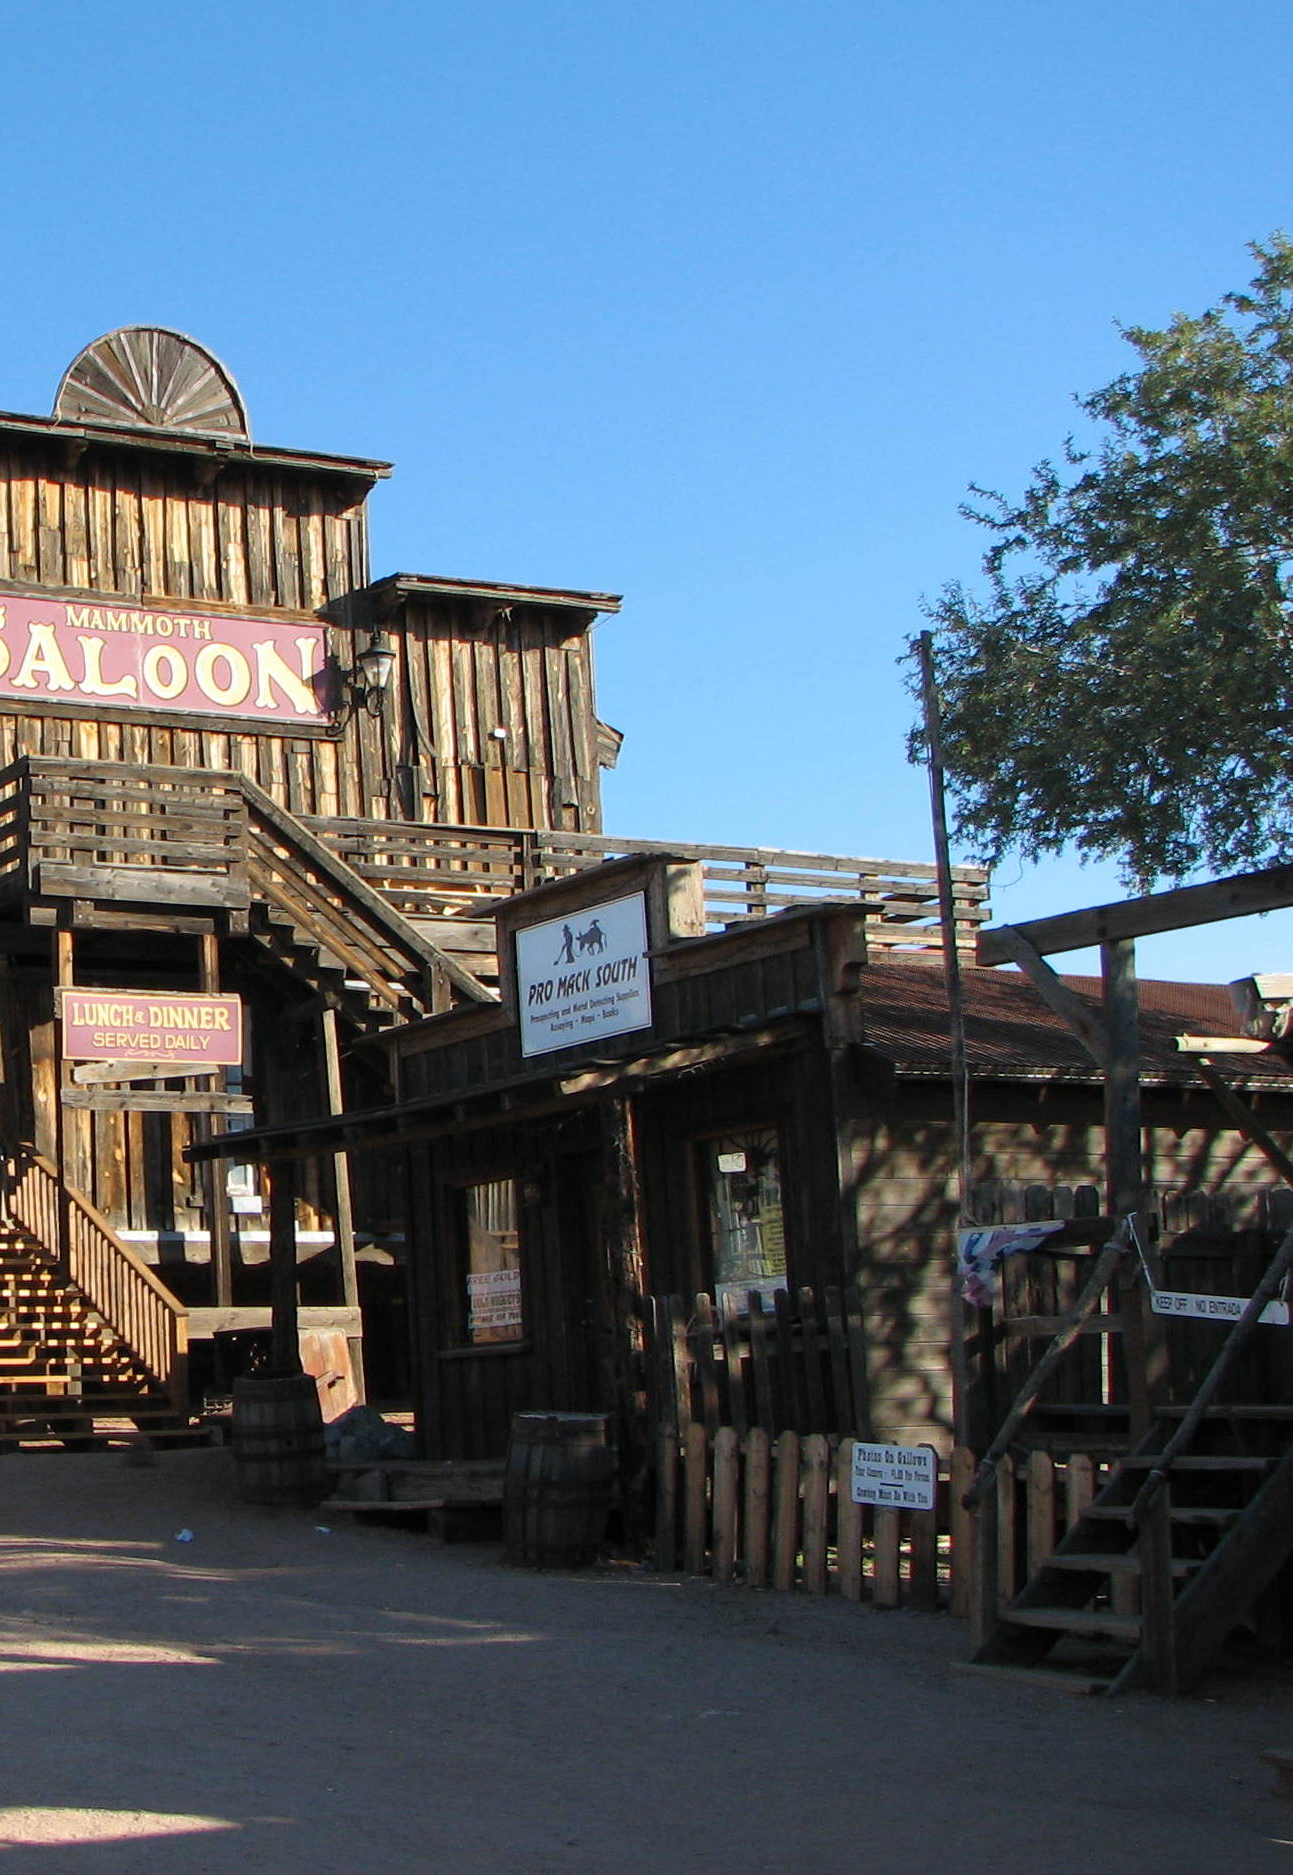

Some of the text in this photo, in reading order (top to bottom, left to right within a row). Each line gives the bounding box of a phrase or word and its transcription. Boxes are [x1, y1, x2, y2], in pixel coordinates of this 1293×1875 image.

[65, 605, 213, 640] MAMMOTH
[528, 956, 637, 1007] PRO MACK SOUTH
[72, 1002, 232, 1032] LUNCH & DINNER
[602, 1008, 619, 1019] Books
[92, 1031, 211, 1050] SERVED DAILY
[1156, 1295, 1172, 1309] KEEP
[1175, 1297, 1187, 1310] OFF
[1195, 1300, 1206, 1313] NO
[897, 1451, 928, 1466] Gallows
